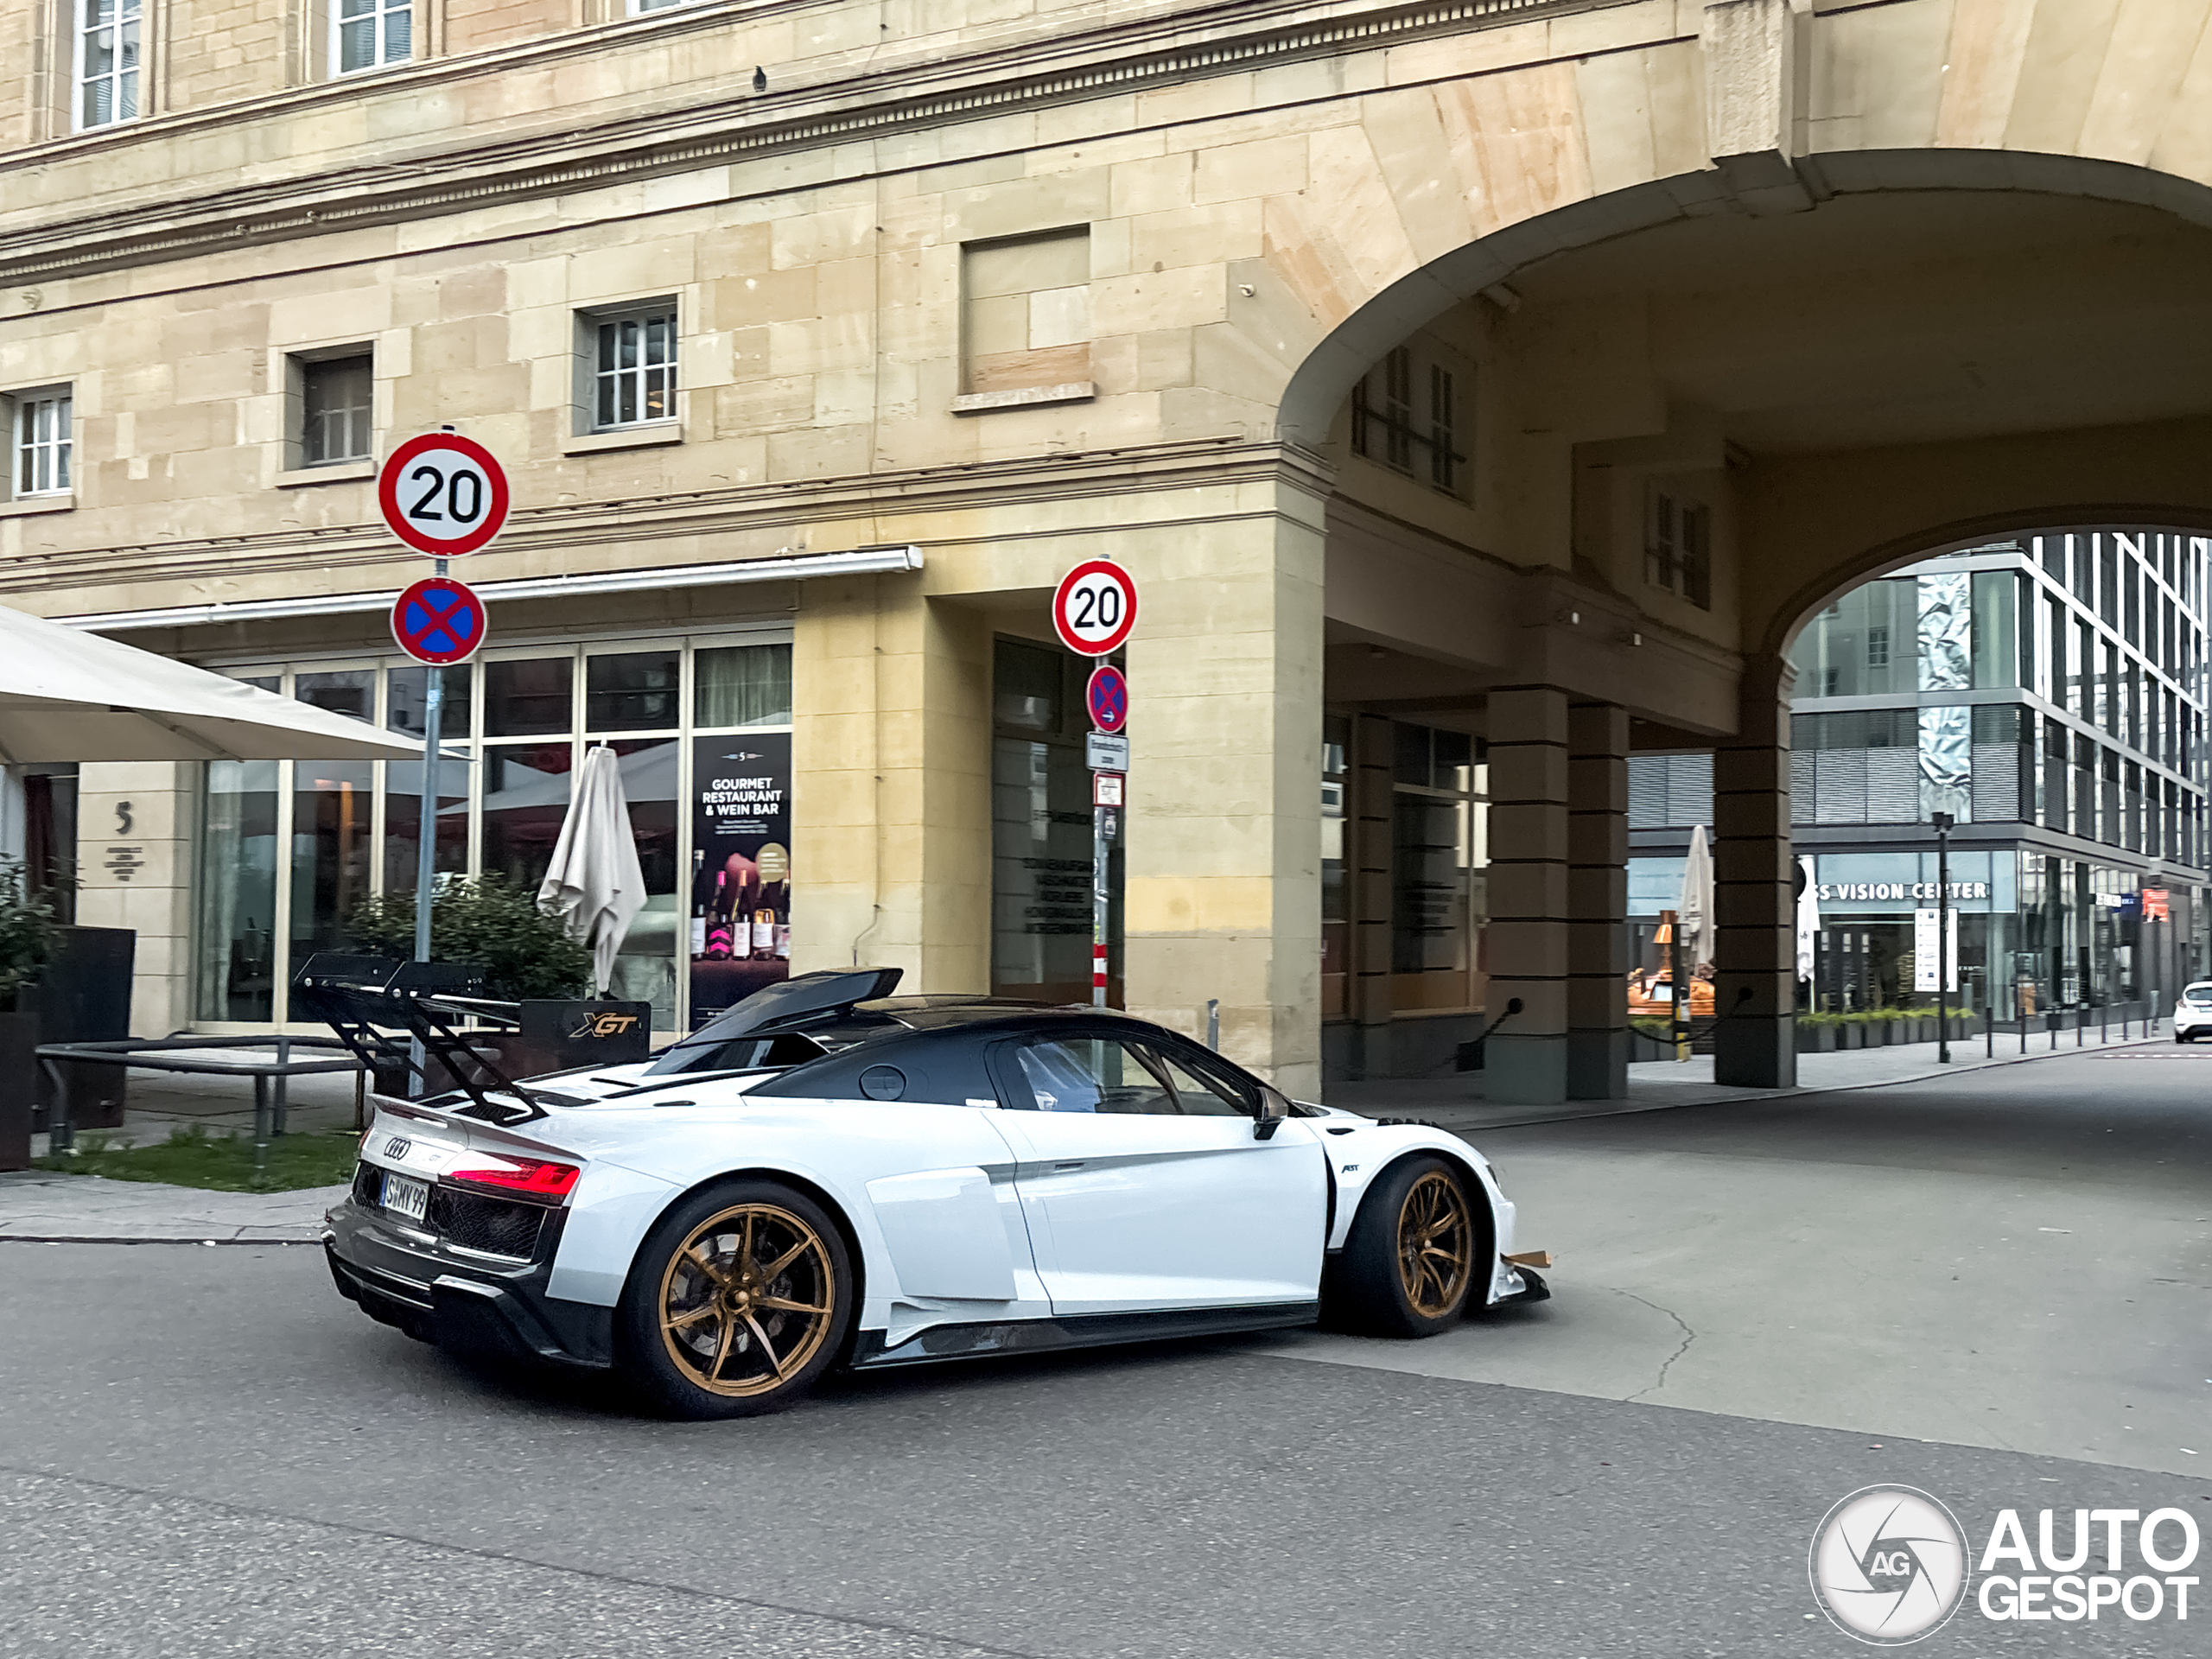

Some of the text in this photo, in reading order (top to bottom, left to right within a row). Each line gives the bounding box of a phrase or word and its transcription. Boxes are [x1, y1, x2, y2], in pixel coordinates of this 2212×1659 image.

[410, 465, 481, 524] 20
[1074, 586, 1119, 628] 20
[712, 778, 772, 790] GOURMET
[702, 790, 782, 804] RESTAURANT
[705, 803, 779, 816] & WEIN BAR
[115, 801, 132, 835] 5
[1836, 883, 1904, 900] VISION
[569, 1013, 639, 1038] XGT
[387, 1178, 395, 1205] S
[412, 1187, 426, 1215] 99
